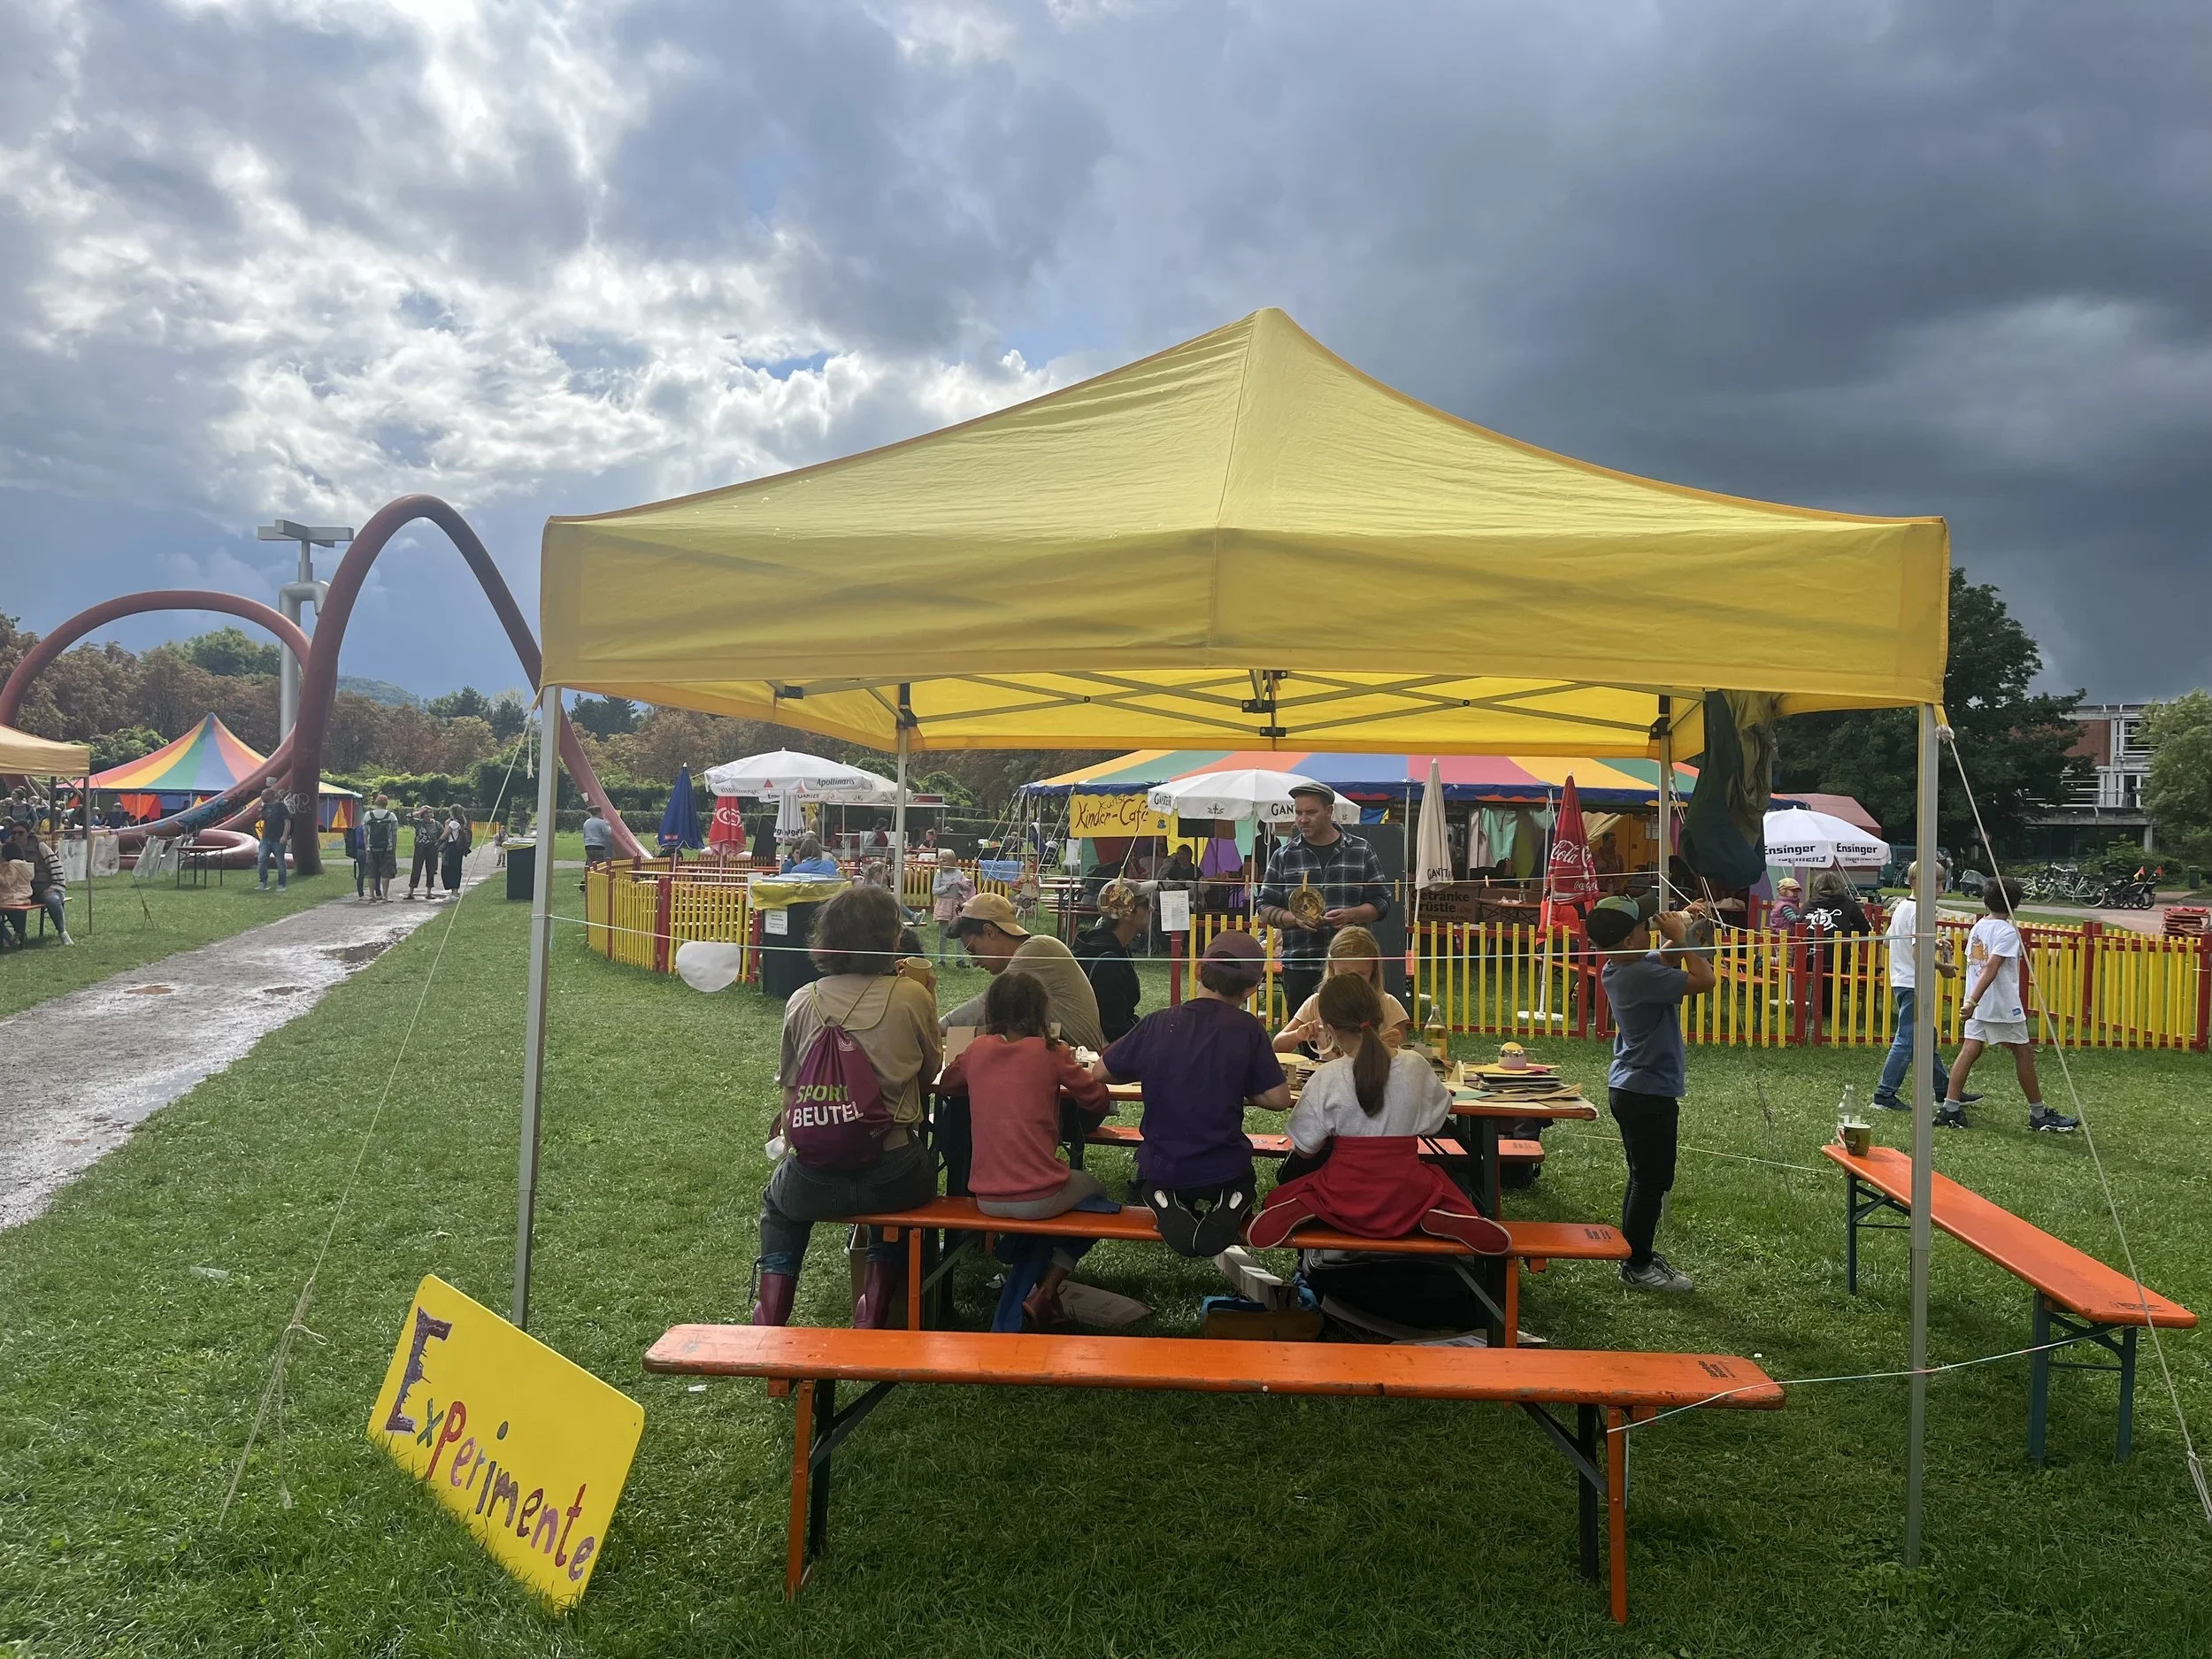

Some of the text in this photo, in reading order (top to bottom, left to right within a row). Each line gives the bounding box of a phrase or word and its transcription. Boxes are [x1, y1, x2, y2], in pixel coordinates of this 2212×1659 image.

[816, 778, 855, 787] Apollinaris
[1271, 803, 1295, 816] GAN
[1836, 842, 1878, 855] Ensinger
[796, 1084, 849, 1103] SPORT
[792, 1101, 864, 1128] BEUTEL
